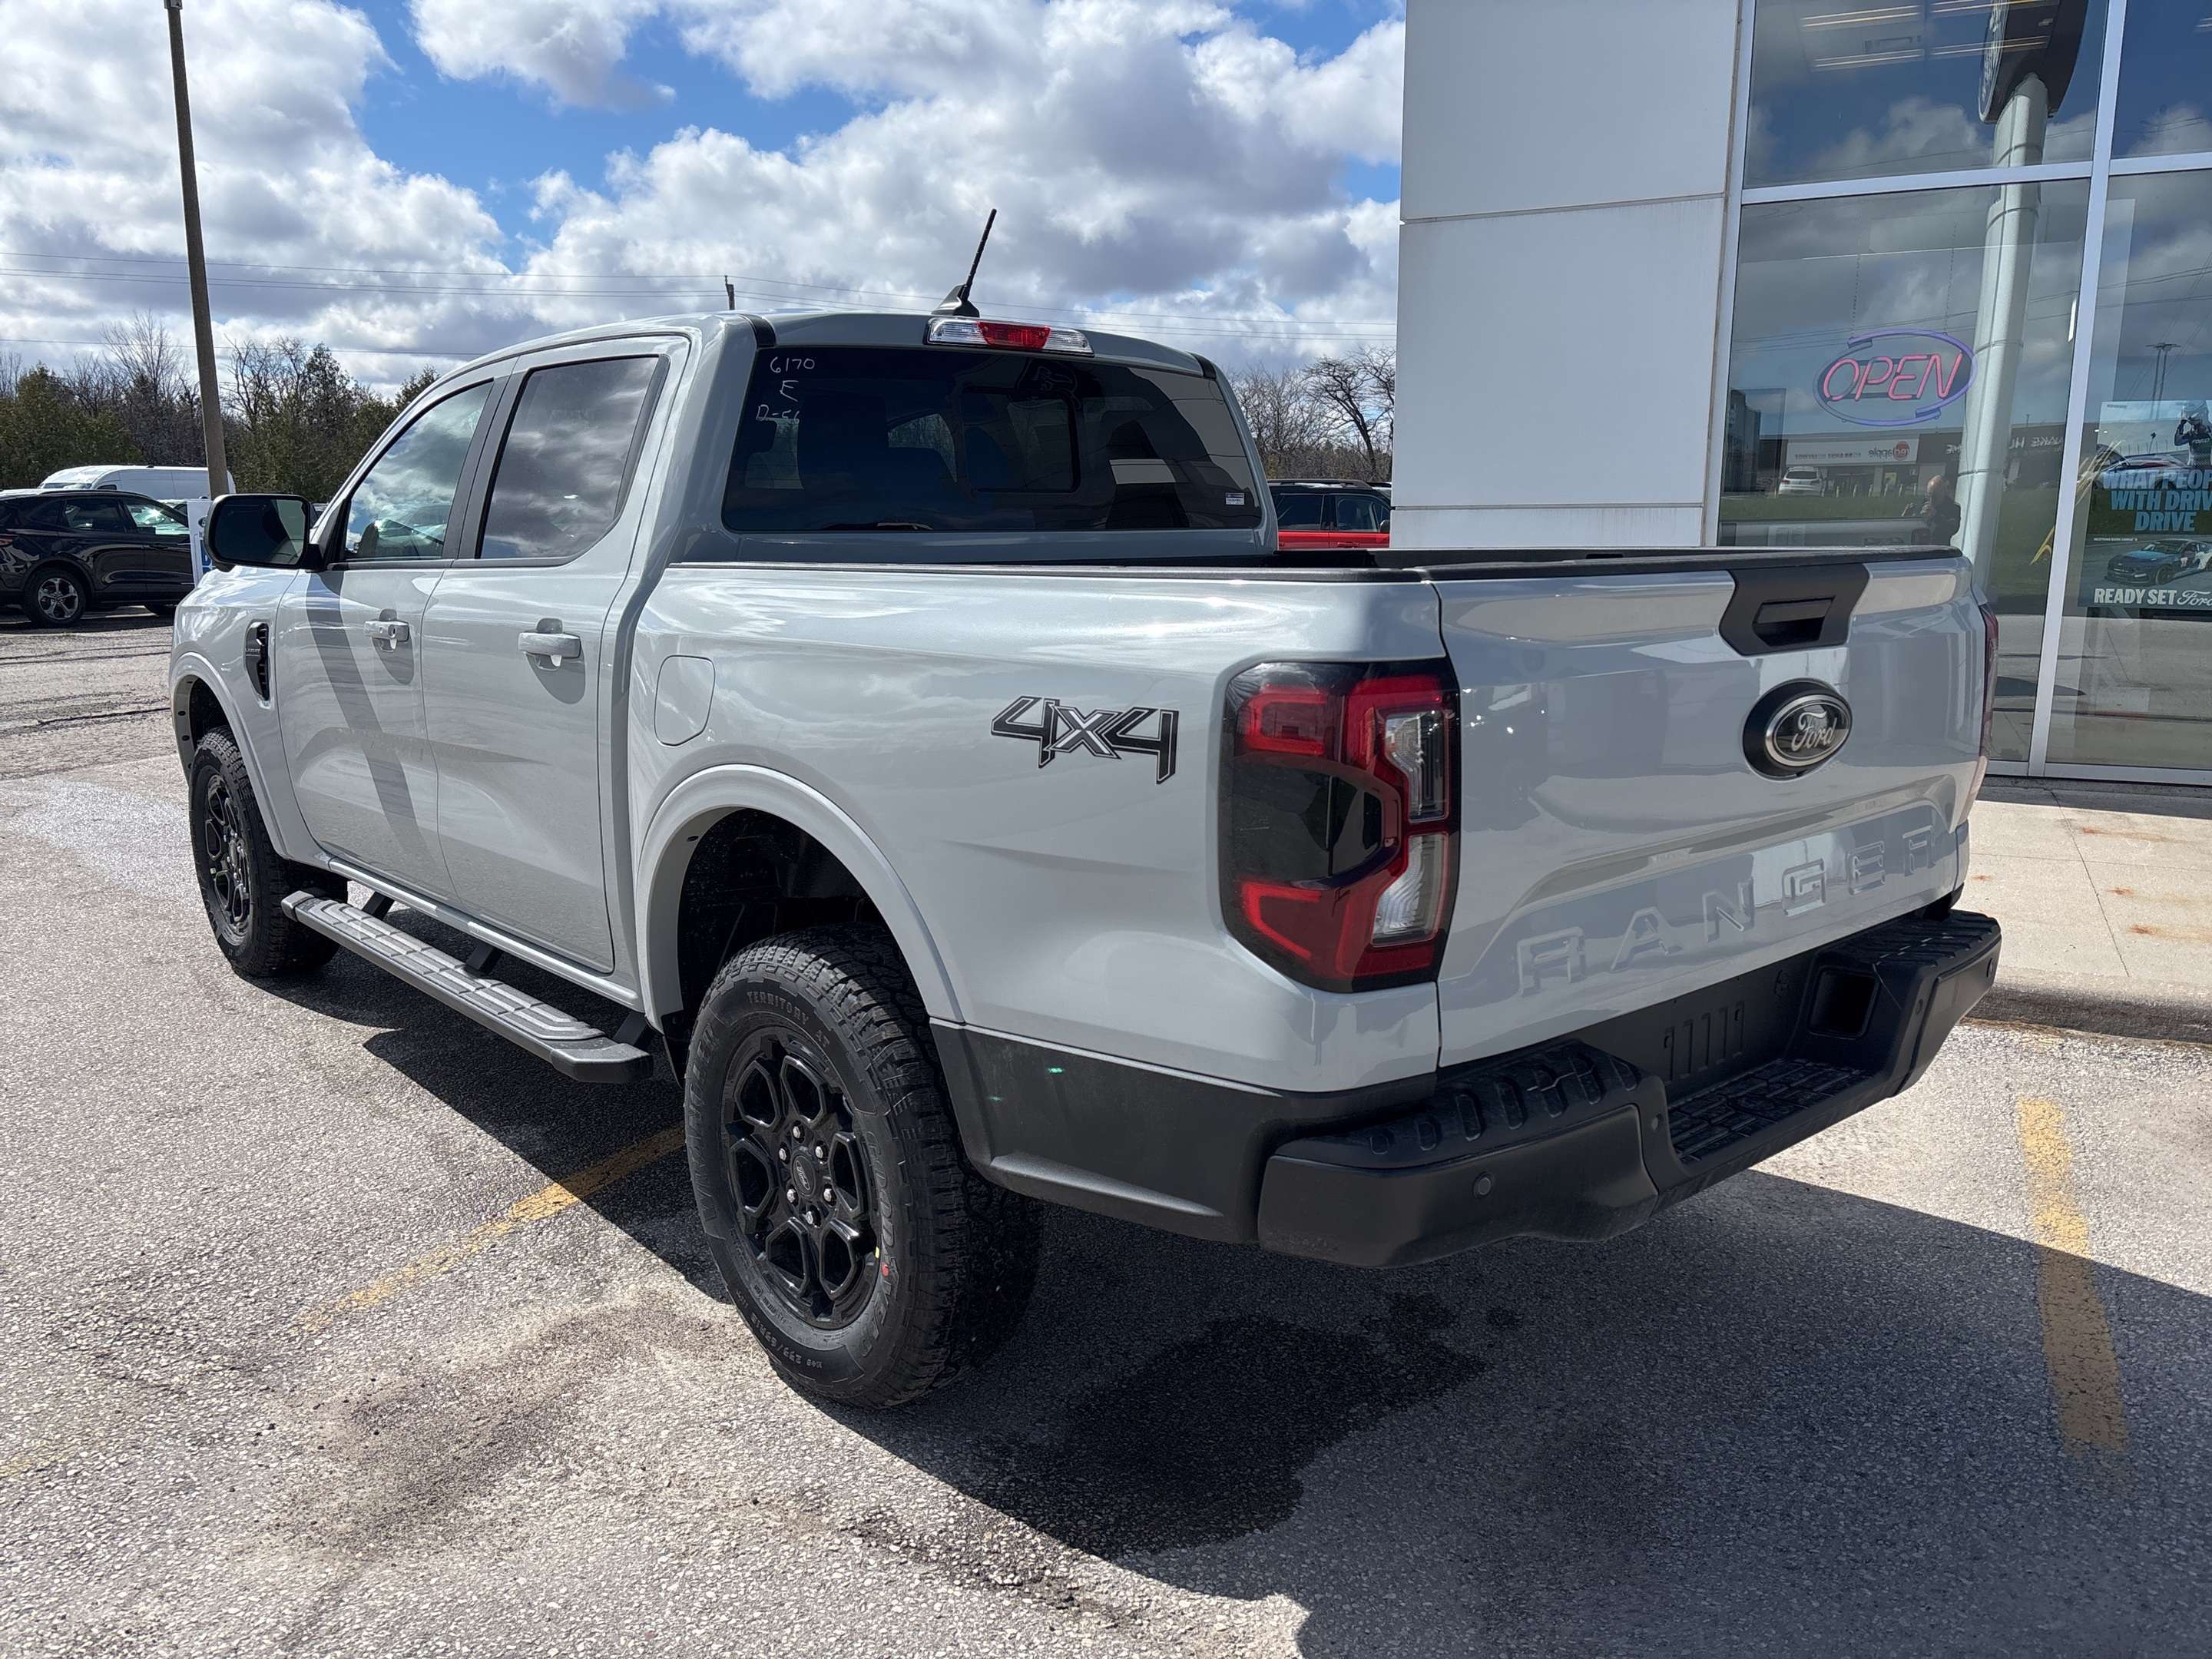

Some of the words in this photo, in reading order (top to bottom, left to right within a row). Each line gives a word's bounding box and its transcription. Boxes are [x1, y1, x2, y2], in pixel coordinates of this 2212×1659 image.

[770, 356, 815, 374] 6170
[1823, 352, 1963, 402] OPEN
[2101, 469, 2156, 489] WHAT
[2111, 490, 2161, 511] WITH
[2134, 512, 2197, 531] DRIVE
[2094, 588, 2146, 604] READY
[2147, 589, 2177, 604] SET
[1790, 711, 1838, 752] Ford
[1516, 824, 1938, 996] RANGER
[746, 990, 810, 1025] TERRITORY
